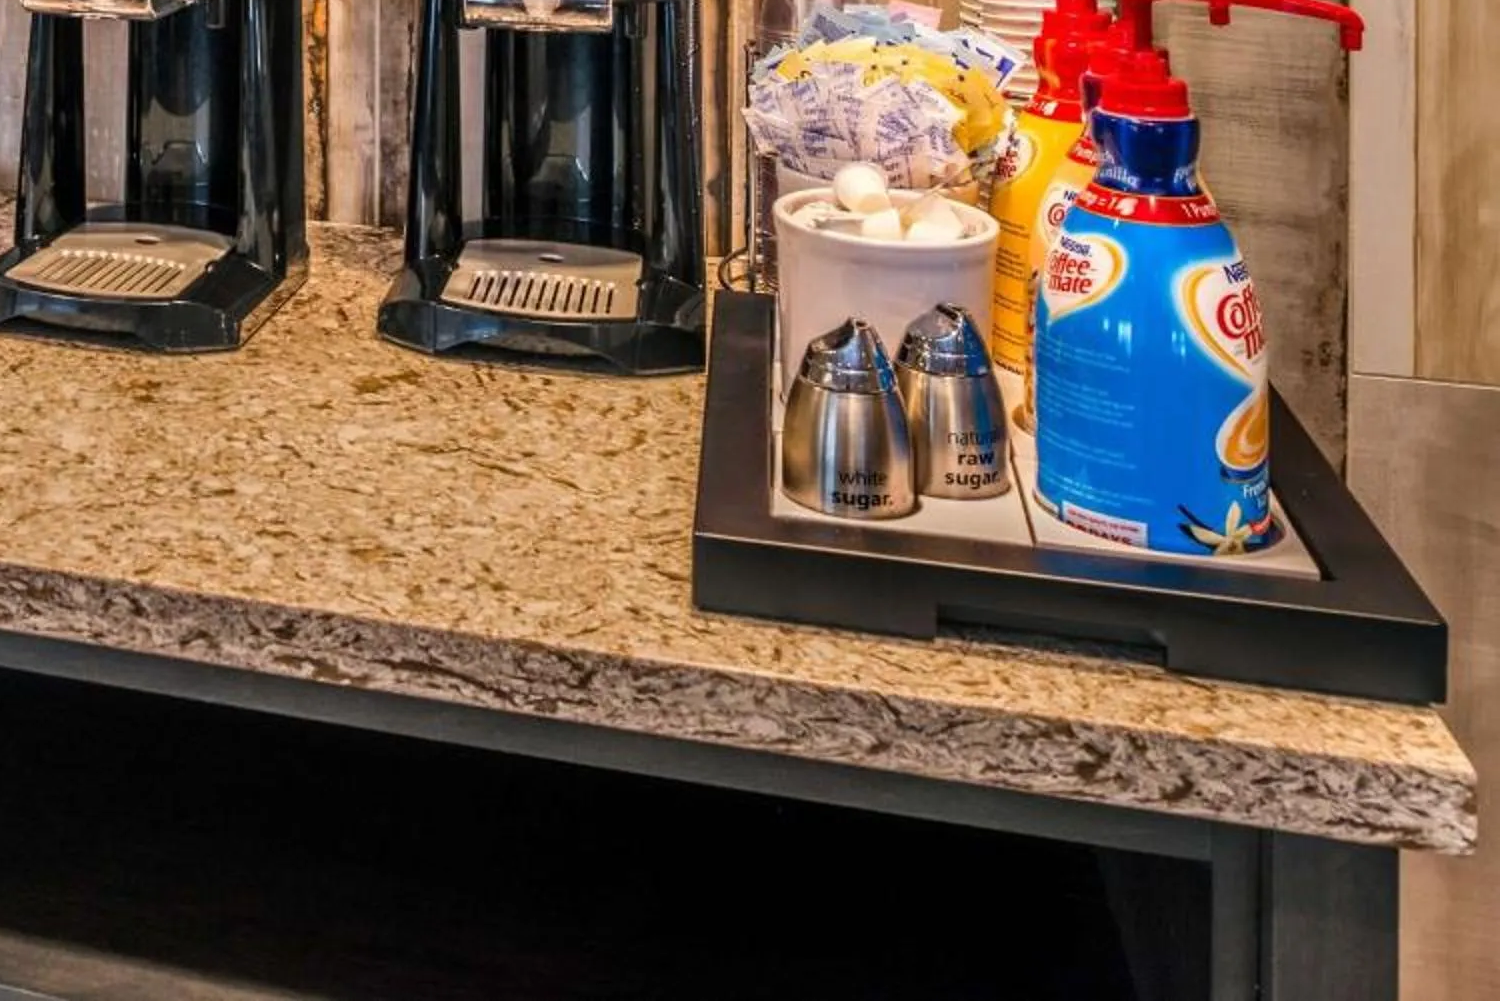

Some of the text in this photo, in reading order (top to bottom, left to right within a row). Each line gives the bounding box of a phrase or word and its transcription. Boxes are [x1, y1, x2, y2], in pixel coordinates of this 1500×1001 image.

[957, 452, 996, 466] raw
[838, 470, 887, 487] white
[831, 491, 894, 511] sugar.
